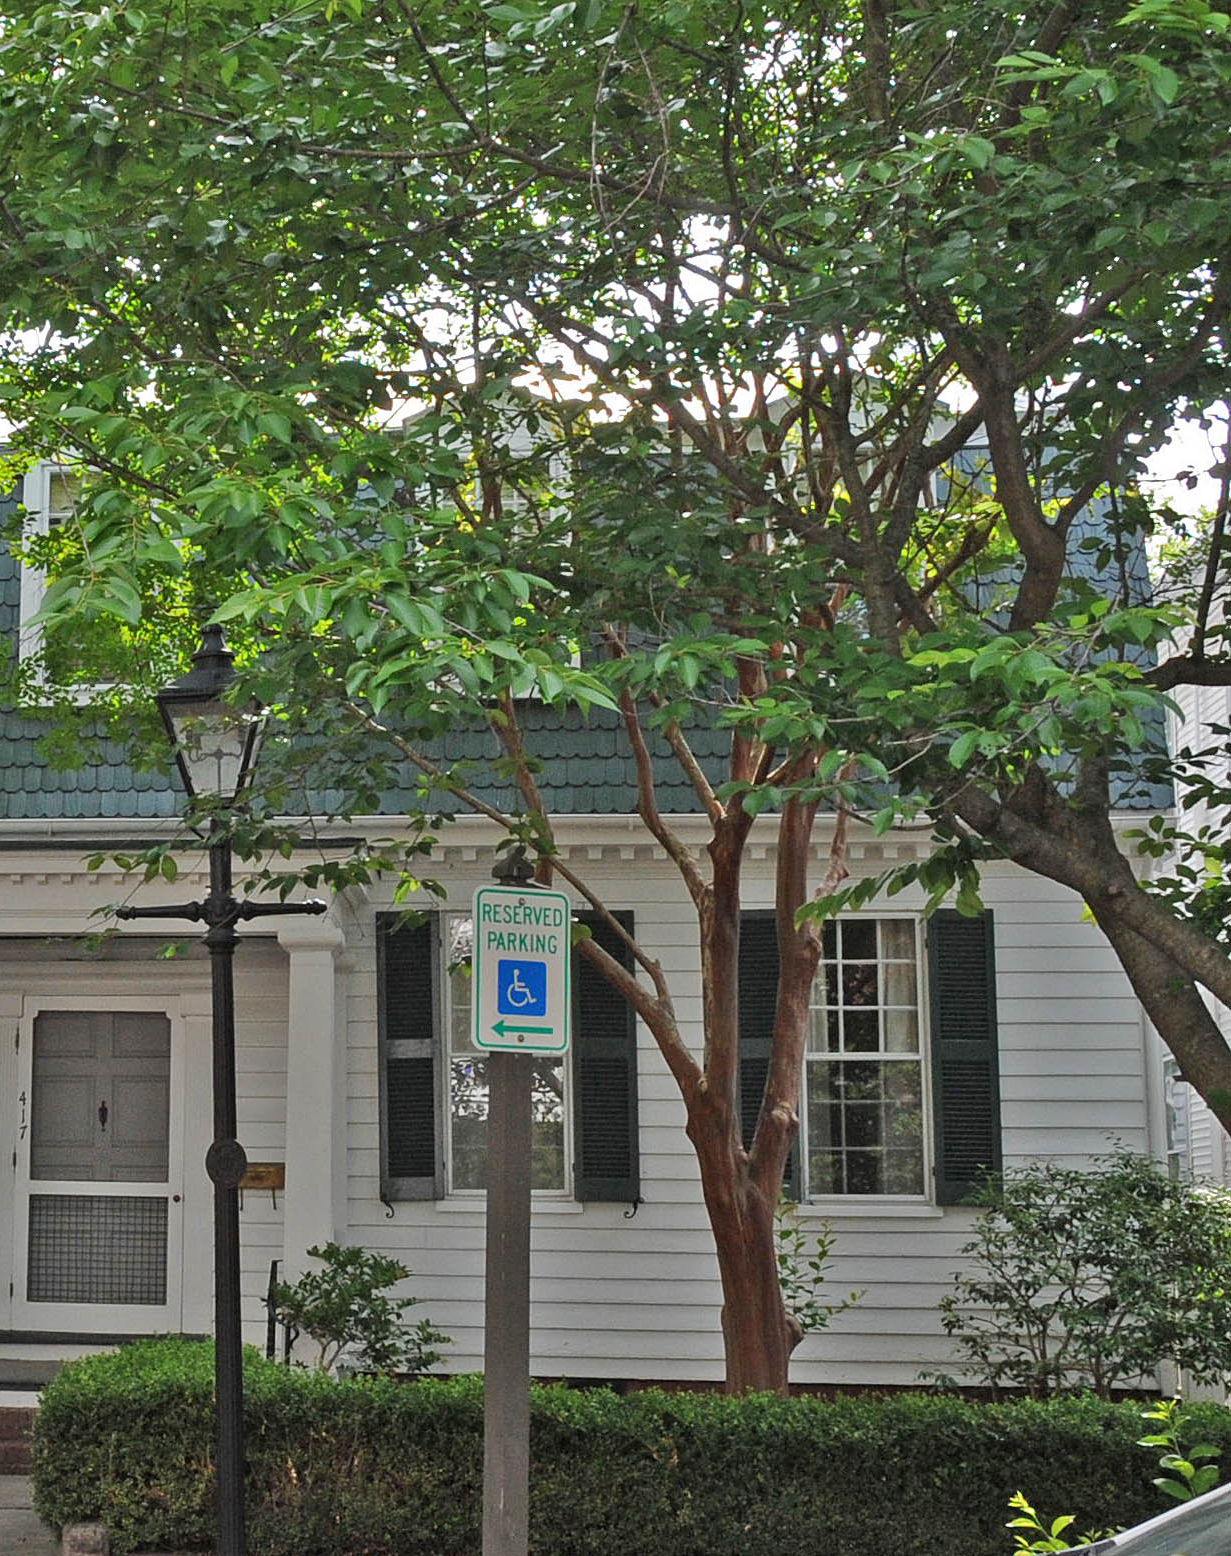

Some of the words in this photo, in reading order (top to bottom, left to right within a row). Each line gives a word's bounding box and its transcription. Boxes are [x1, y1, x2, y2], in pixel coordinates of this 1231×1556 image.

[482, 903, 563, 927] RESERVED
[487, 931, 558, 954] PARKING
[18, 1090, 28, 1141] 417
